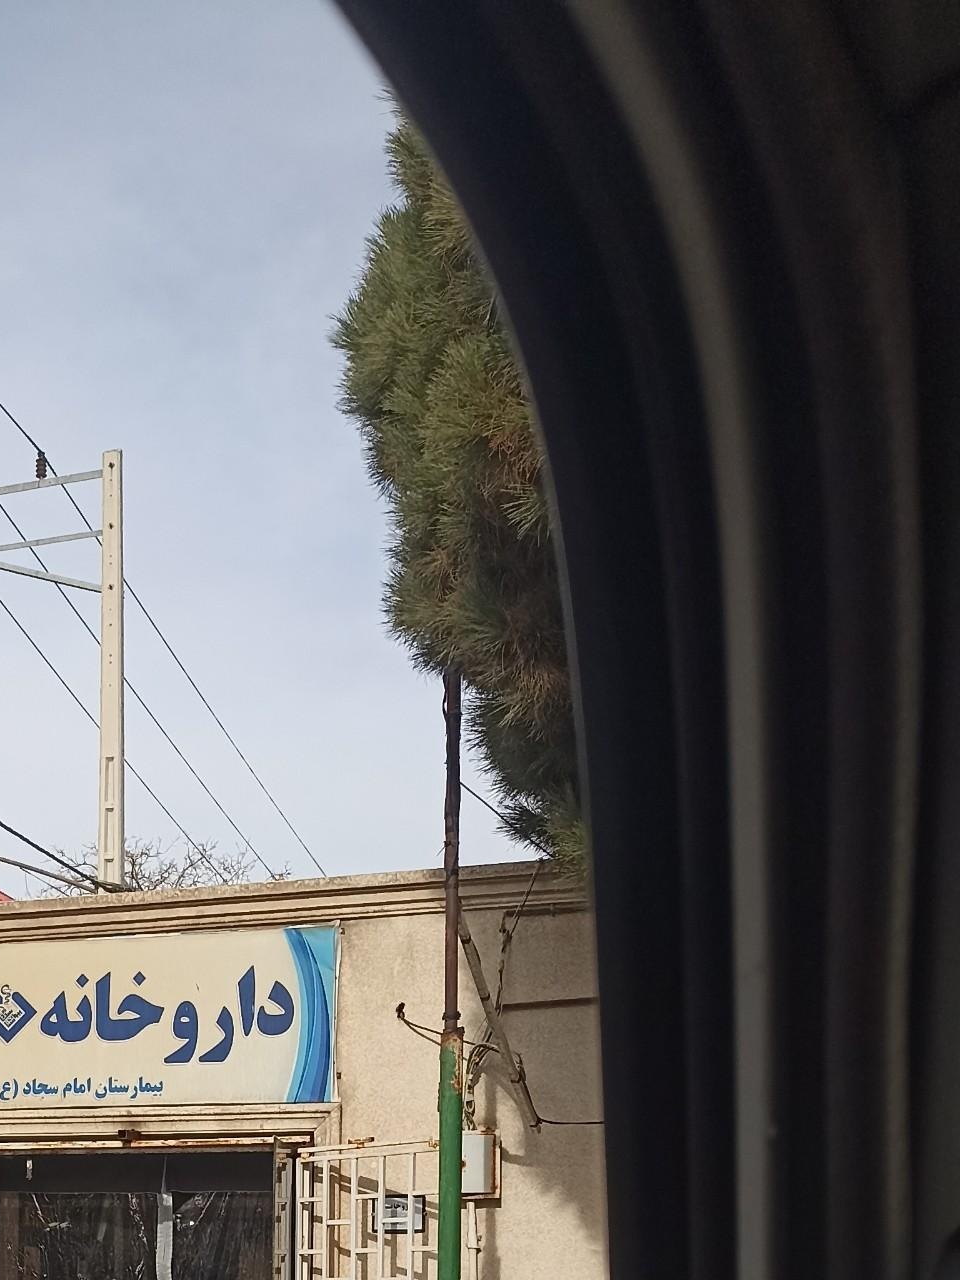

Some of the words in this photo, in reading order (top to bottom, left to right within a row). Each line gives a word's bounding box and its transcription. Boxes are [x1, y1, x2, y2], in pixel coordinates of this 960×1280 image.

[40, 964, 295, 1065] داروخانه
[22, 1078, 58, 1099] سجاد
[62, 1077, 91, 1099] امام
[94, 1076, 164, 1099] بیمارستان
